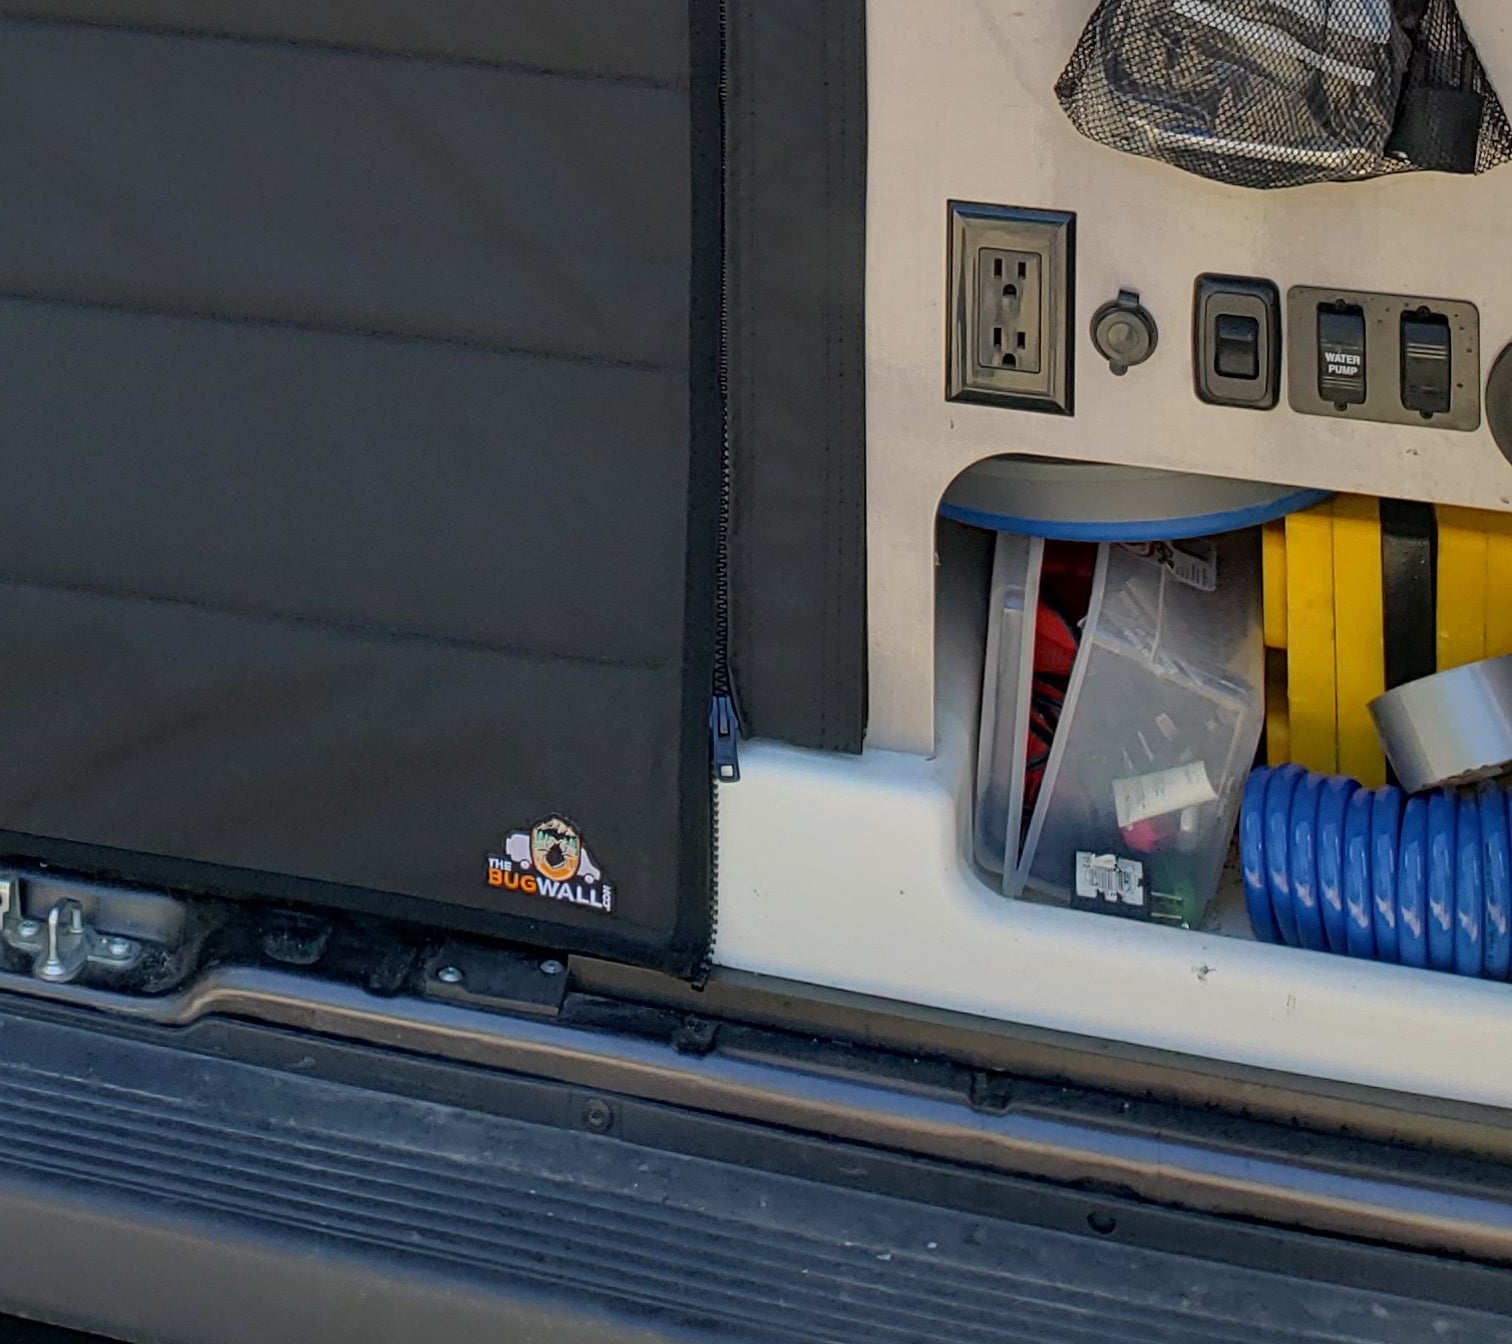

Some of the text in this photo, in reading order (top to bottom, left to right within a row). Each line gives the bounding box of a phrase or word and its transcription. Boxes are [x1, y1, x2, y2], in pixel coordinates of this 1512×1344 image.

[1324, 352, 1360, 365] WATER
[1328, 364, 1358, 375] PUMP
[488, 857, 512, 871] THE
